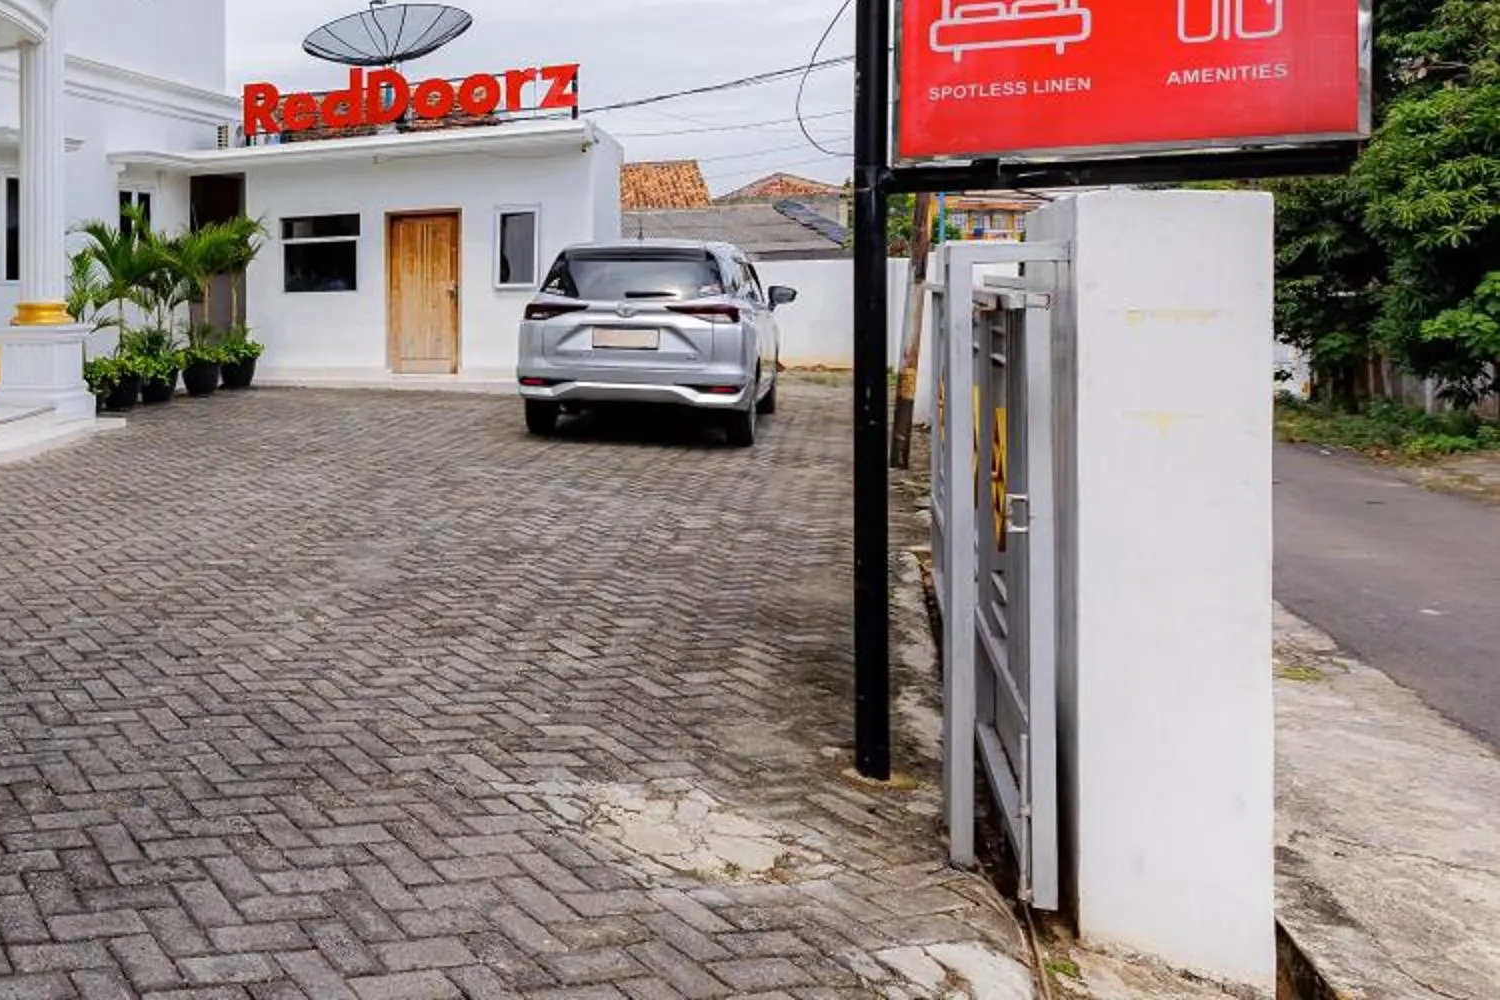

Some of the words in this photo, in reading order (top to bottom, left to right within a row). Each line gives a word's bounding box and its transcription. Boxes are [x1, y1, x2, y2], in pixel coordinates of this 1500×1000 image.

[1166, 62, 1288, 86] AMENITIES
[243, 62, 580, 136] RedDoorz
[928, 79, 1027, 101] SPOTLESS
[1032, 76, 1091, 95] LINEN
